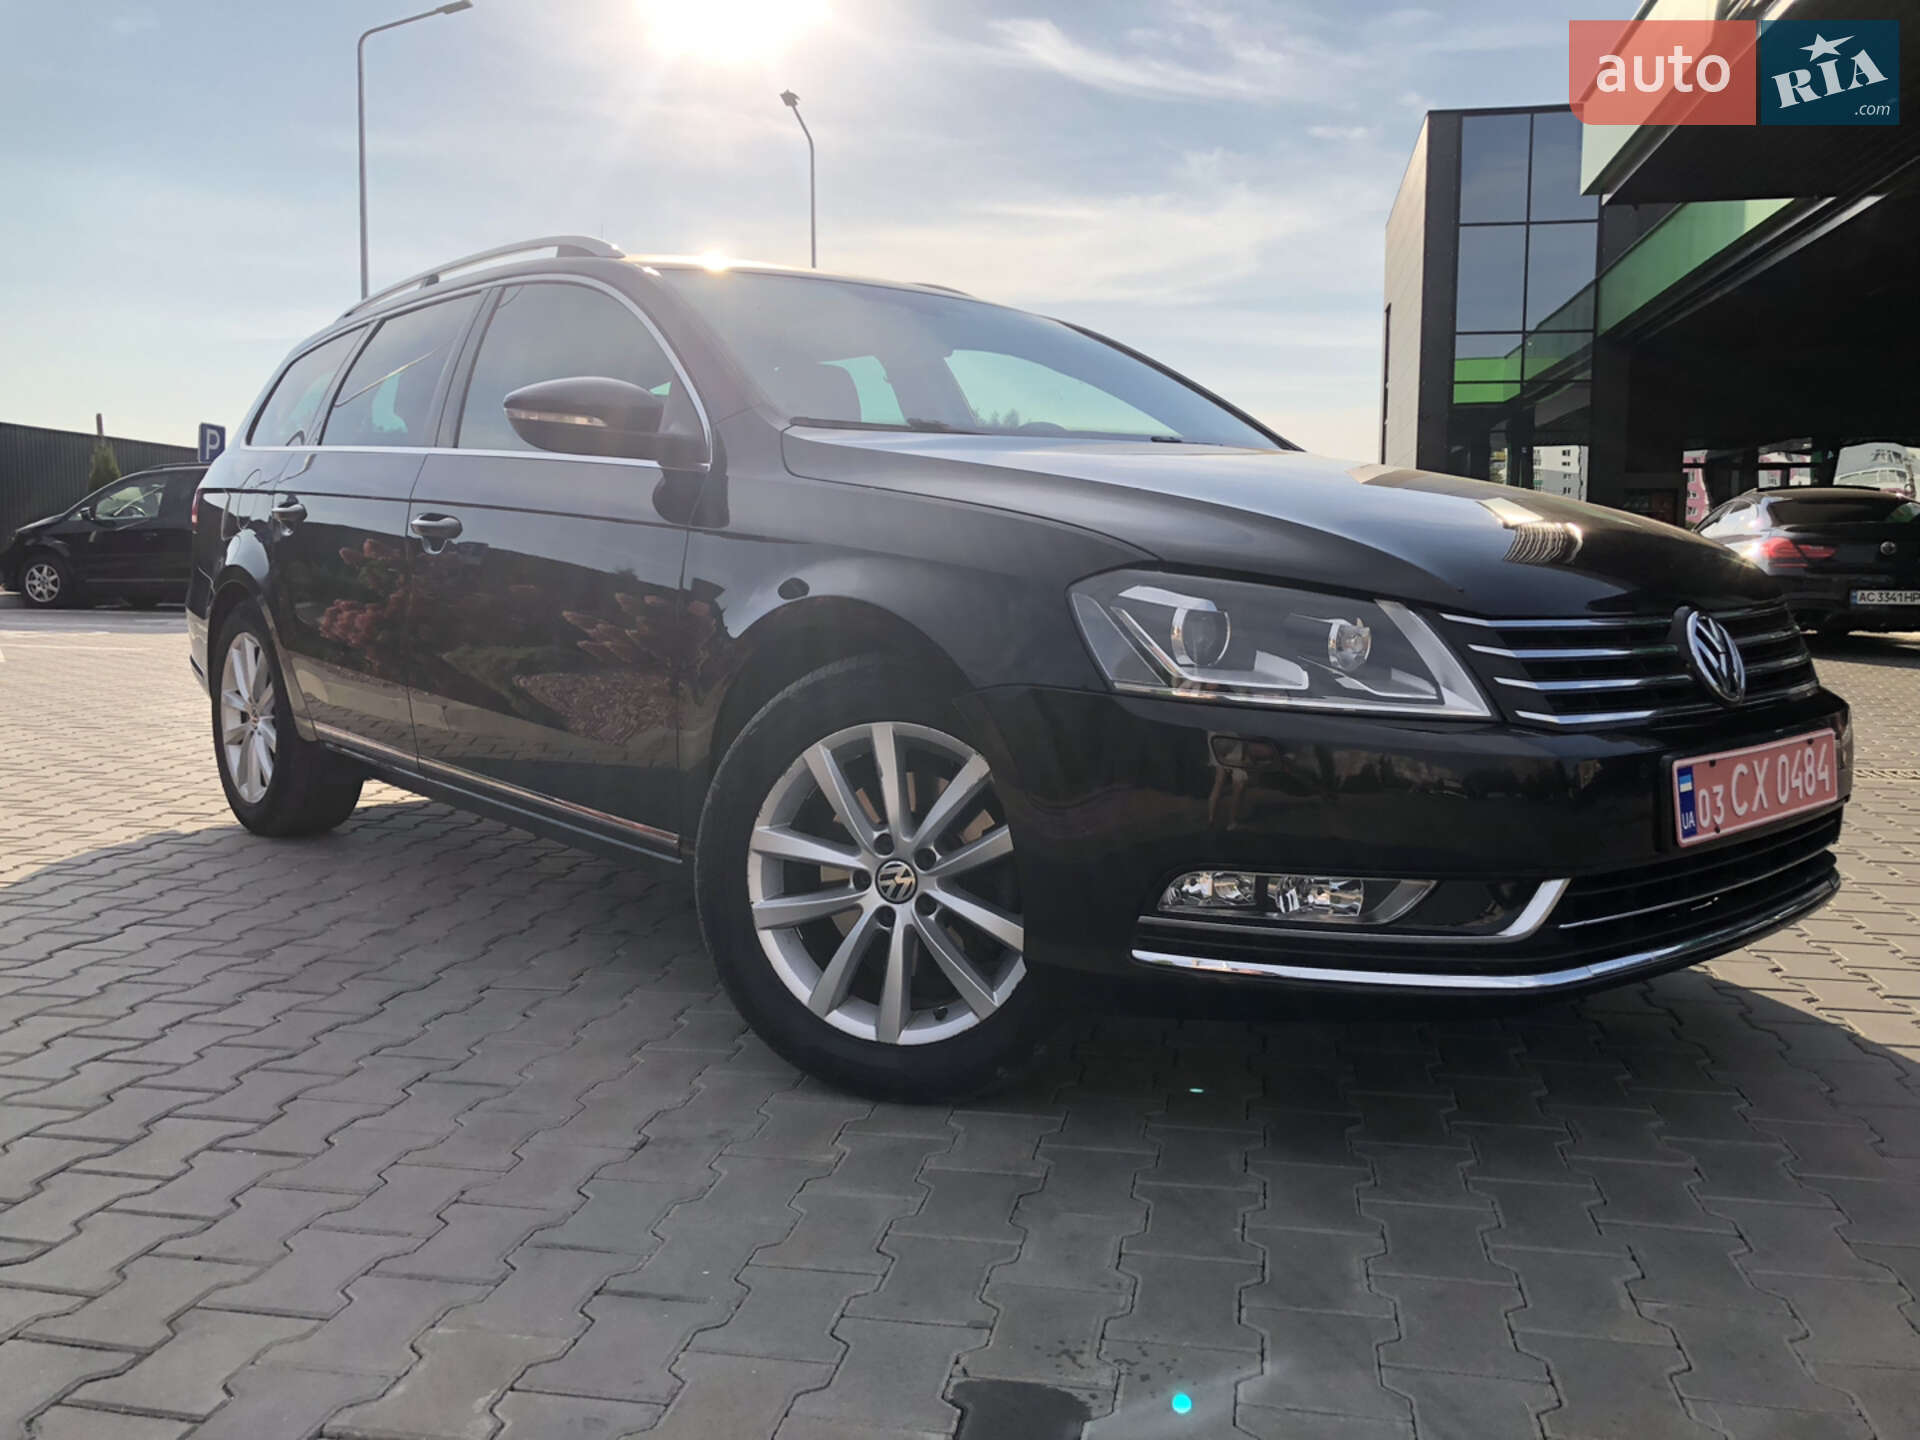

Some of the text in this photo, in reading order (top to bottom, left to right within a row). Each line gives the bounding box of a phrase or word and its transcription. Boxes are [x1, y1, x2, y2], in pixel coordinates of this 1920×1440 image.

[206, 429, 220, 460] P
[1699, 743, 1830, 828] 03 CX 0484
[1681, 811, 1696, 830] UA
